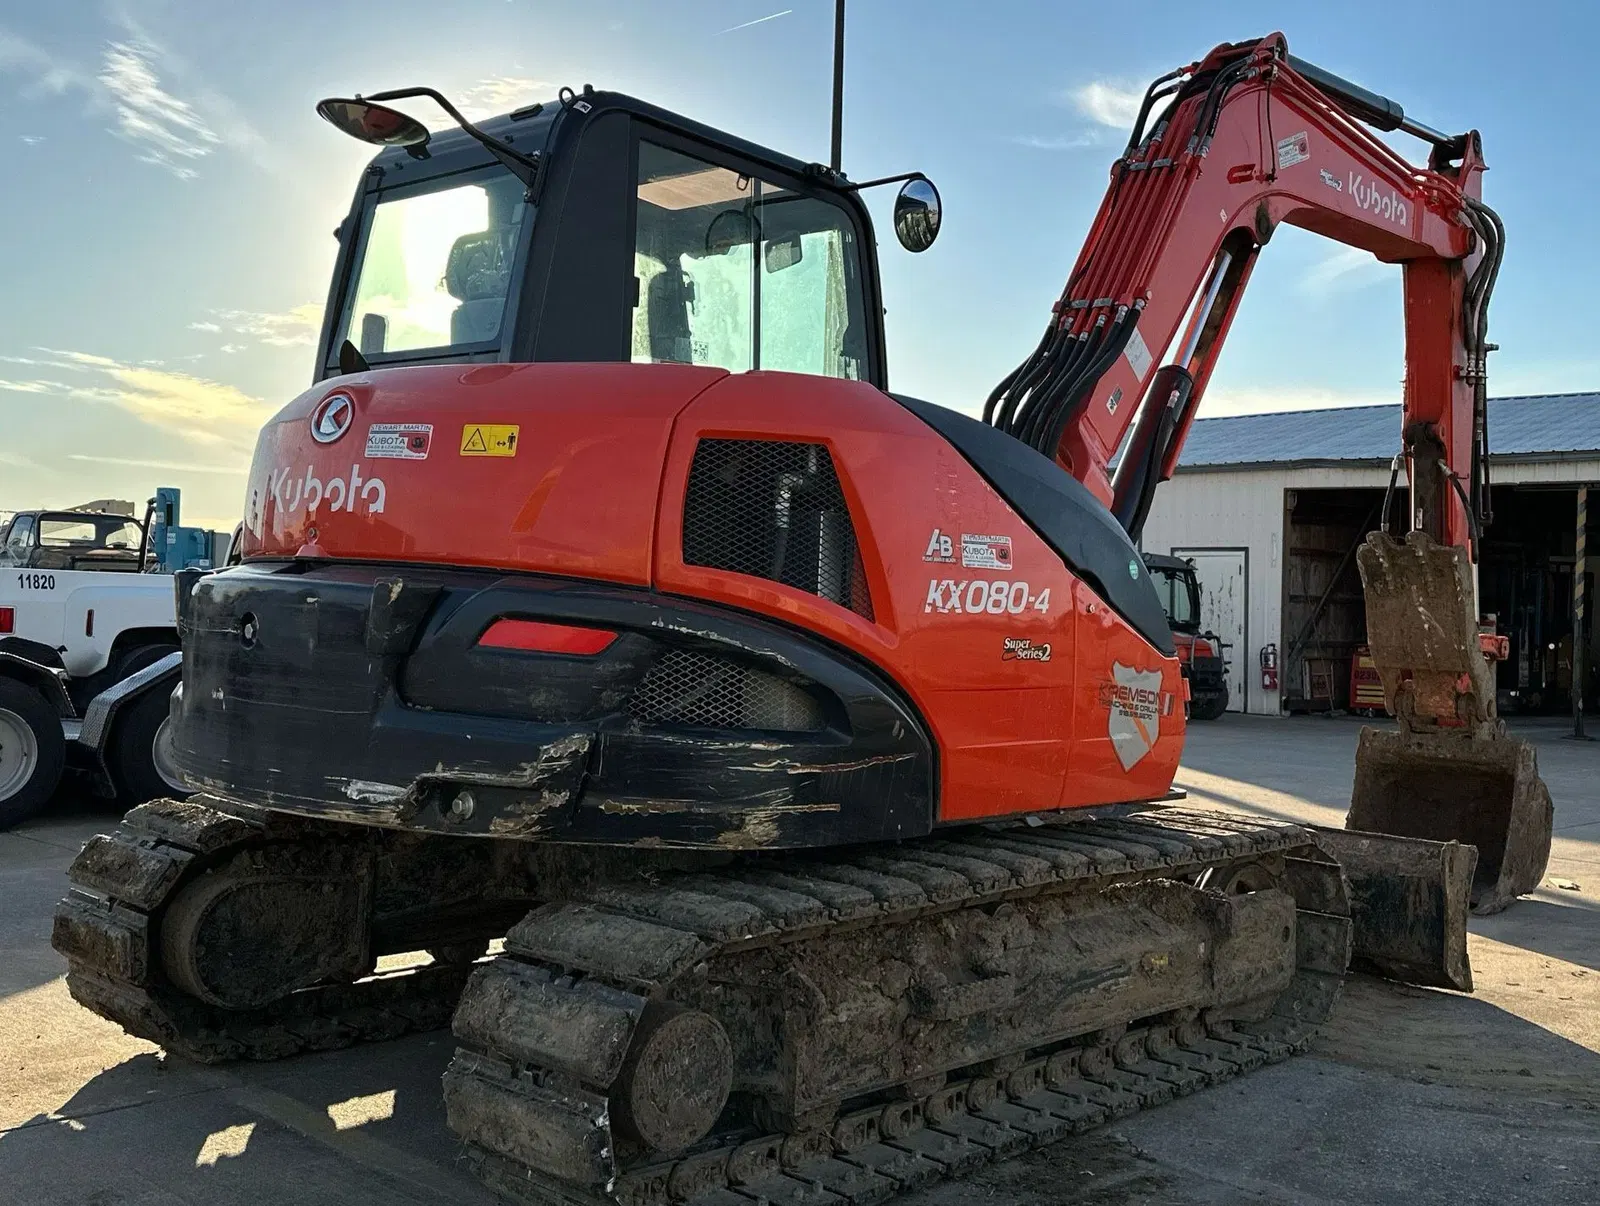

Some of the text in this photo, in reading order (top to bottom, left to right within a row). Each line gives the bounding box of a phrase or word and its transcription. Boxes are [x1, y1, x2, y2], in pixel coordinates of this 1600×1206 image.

[1348, 171, 1407, 227] Kubota
[367, 434, 406, 445] KUBOTA
[269, 464, 386, 513] Kubota
[925, 528, 954, 557] AB
[962, 545, 995, 556] KUBOTA
[18, 574, 56, 590] 11820
[924, 579, 1051, 614] KX080-4
[1003, 637, 1031, 650] Super
